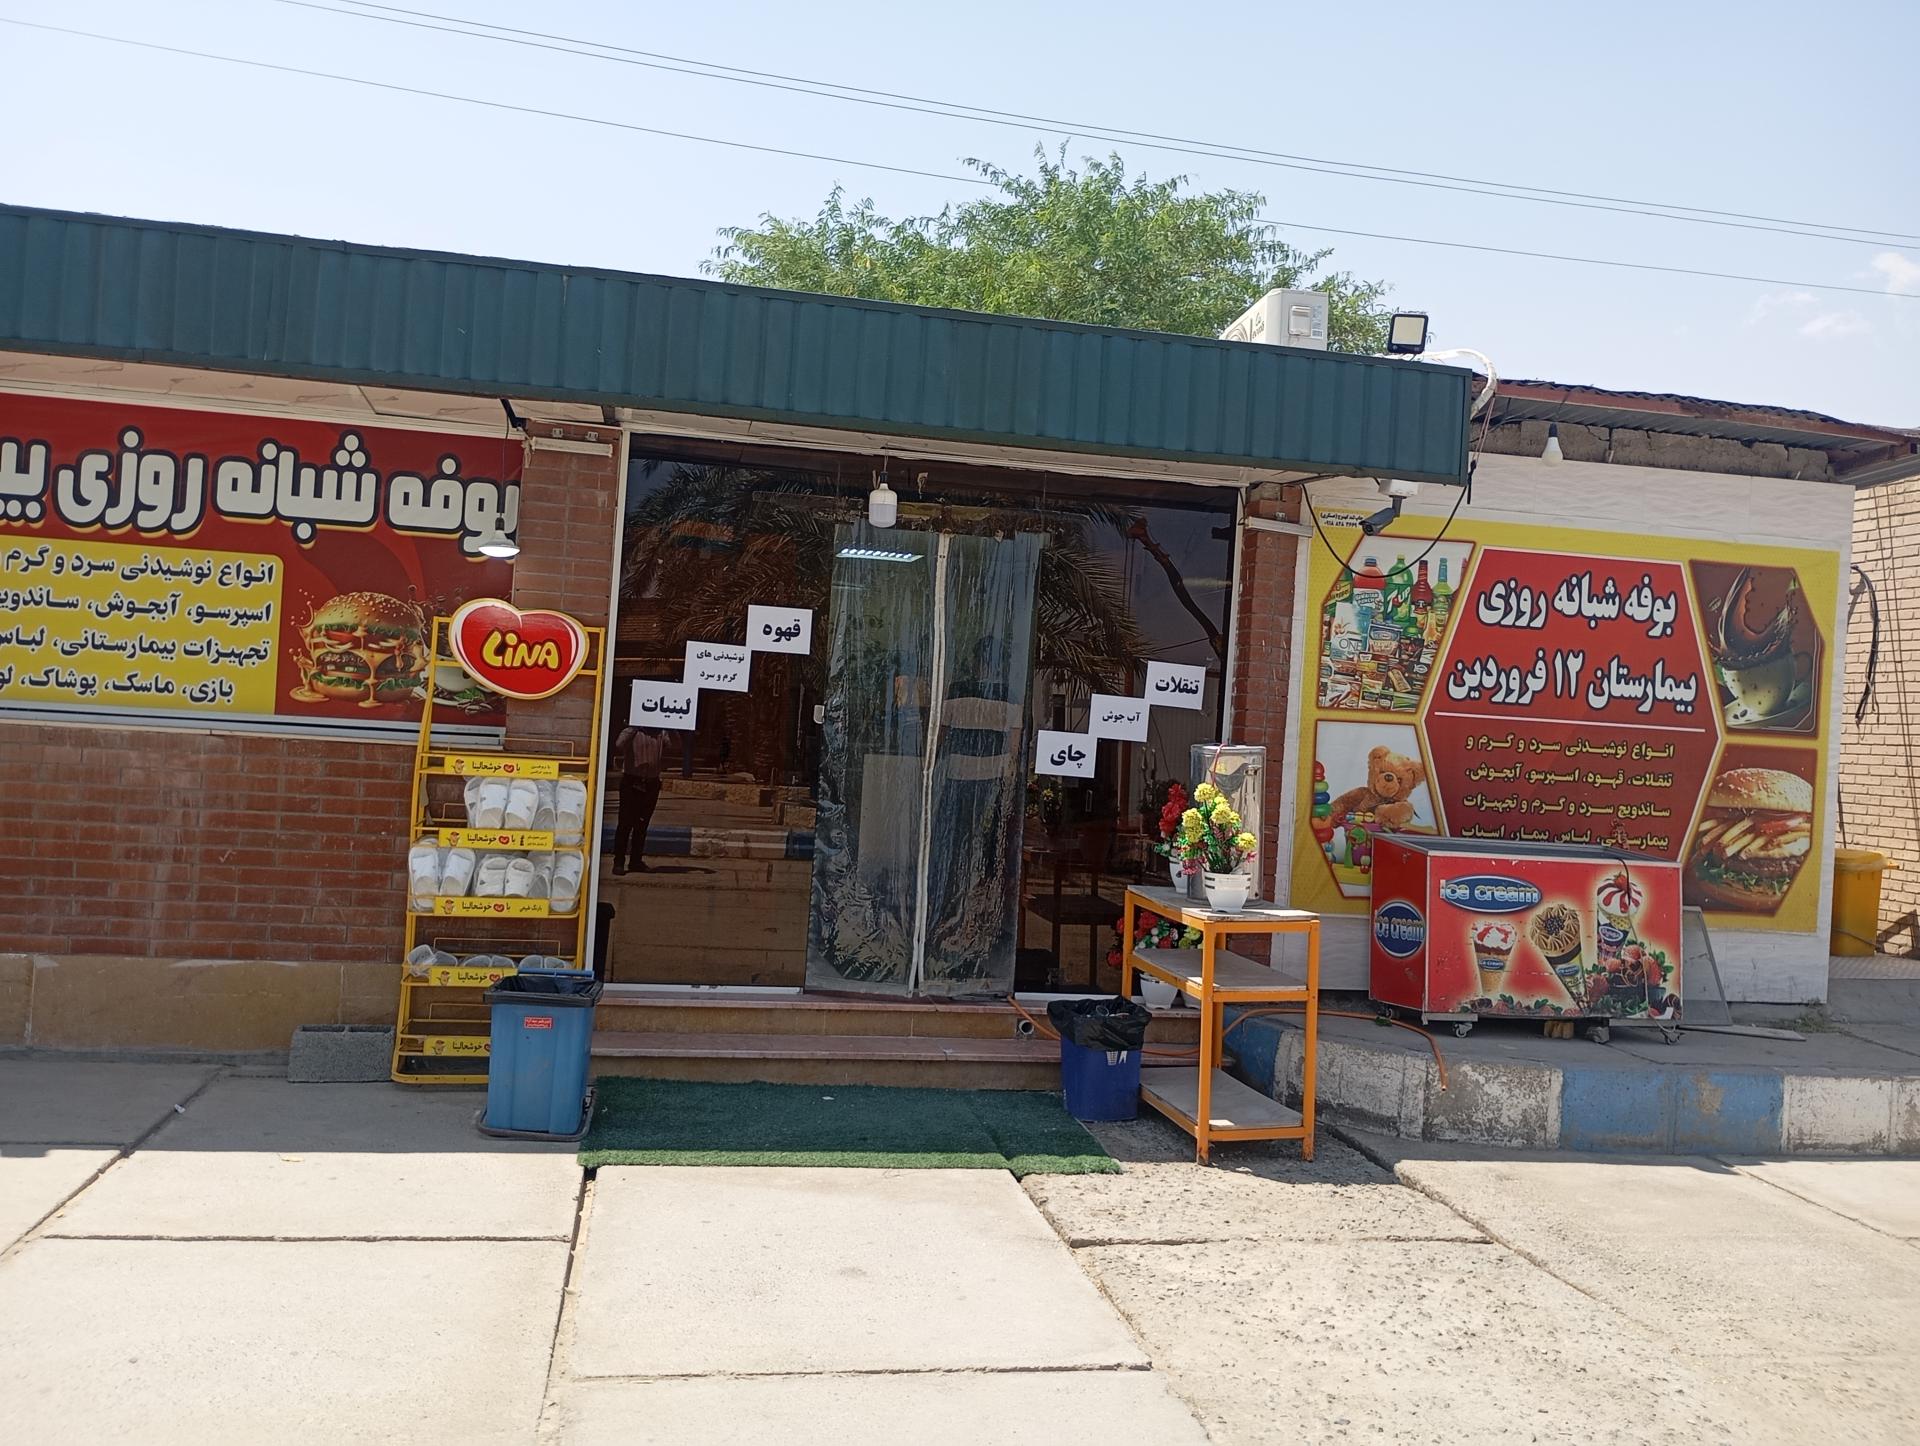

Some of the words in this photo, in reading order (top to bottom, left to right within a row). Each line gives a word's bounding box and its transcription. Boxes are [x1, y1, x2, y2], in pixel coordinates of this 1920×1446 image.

[56, 428, 206, 532] روزی
[216, 433, 377, 540] شبانه
[5, 546, 49, 572] گرم
[53, 555, 65, 574] و
[71, 555, 114, 577] سرد
[121, 554, 212, 584] نوشیدنی
[217, 562, 275, 587] انواع
[0, 588, 80, 611] ساندوی
[88, 593, 181, 621] آبجوش،
[1478, 579, 1548, 628] روزی
[1553, 572, 1620, 628] شبانه
[1624, 575, 1677, 637] بوفه
[186, 603, 272, 626] اسپرسو،
[762, 618, 802, 643] قهوه
[53, 630, 176, 661] بیمارستانی،
[183, 638, 270, 667] تجهیزات
[696, 649, 712, 660] های
[713, 650, 745, 664] نوشیدنی
[21, 667, 97, 696] پوشاک،
[104, 673, 175, 694] ماسک،
[700, 671, 715, 681] سرد
[716, 673, 721, 682] و
[722, 671, 738, 682] گرم
[1155, 675, 1200, 695] تنقلات
[1448, 649, 1548, 705] فروردین
[1553, 650, 1585, 698] ۱۲
[1587, 655, 1698, 713] بیمارستان
[183, 678, 234, 704] بازی،
[641, 695, 692, 719] لبنیات
[1102, 711, 1125, 724] جوش
[1127, 711, 1142, 723] آب
[1466, 736, 1473, 749] و
[1478, 733, 1515, 750] گرم
[1517, 738, 1525, 752] و
[1529, 738, 1561, 753] سرد
[1565, 737, 1627, 759] نوشیدنی
[1631, 743, 1675, 761] انواع
[1050, 744, 1087, 769] چای
[1463, 793, 1519, 813] تجهیزات
[1520, 799, 1528, 813] و
[1531, 797, 1566, 814] گرم
[1568, 802, 1575, 816] و
[1578, 800, 1614, 816] سرد
[1617, 802, 1671, 818] ساندویچ
[1474, 884, 1540, 903] cream
